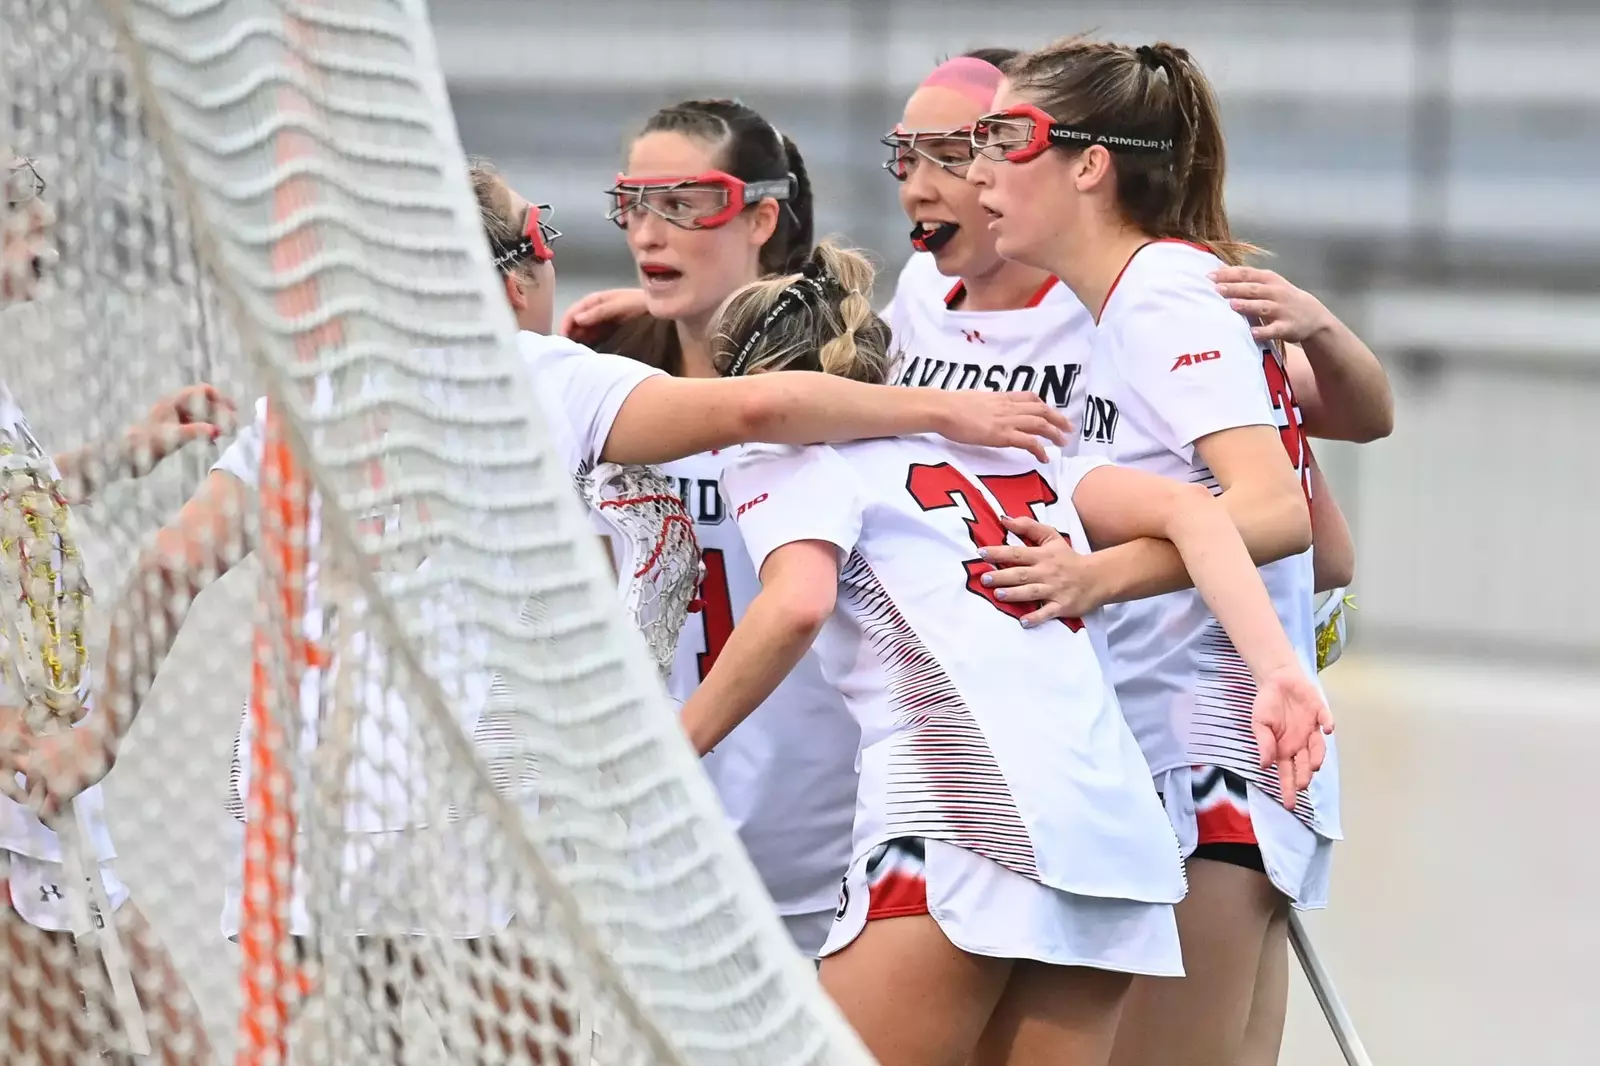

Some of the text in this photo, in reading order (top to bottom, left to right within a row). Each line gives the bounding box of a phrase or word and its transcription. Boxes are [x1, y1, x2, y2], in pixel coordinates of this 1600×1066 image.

[1049, 129, 1159, 149] NDER ARMOUR
[1170, 350, 1221, 372] A10
[896, 356, 1082, 408] AVIDSON
